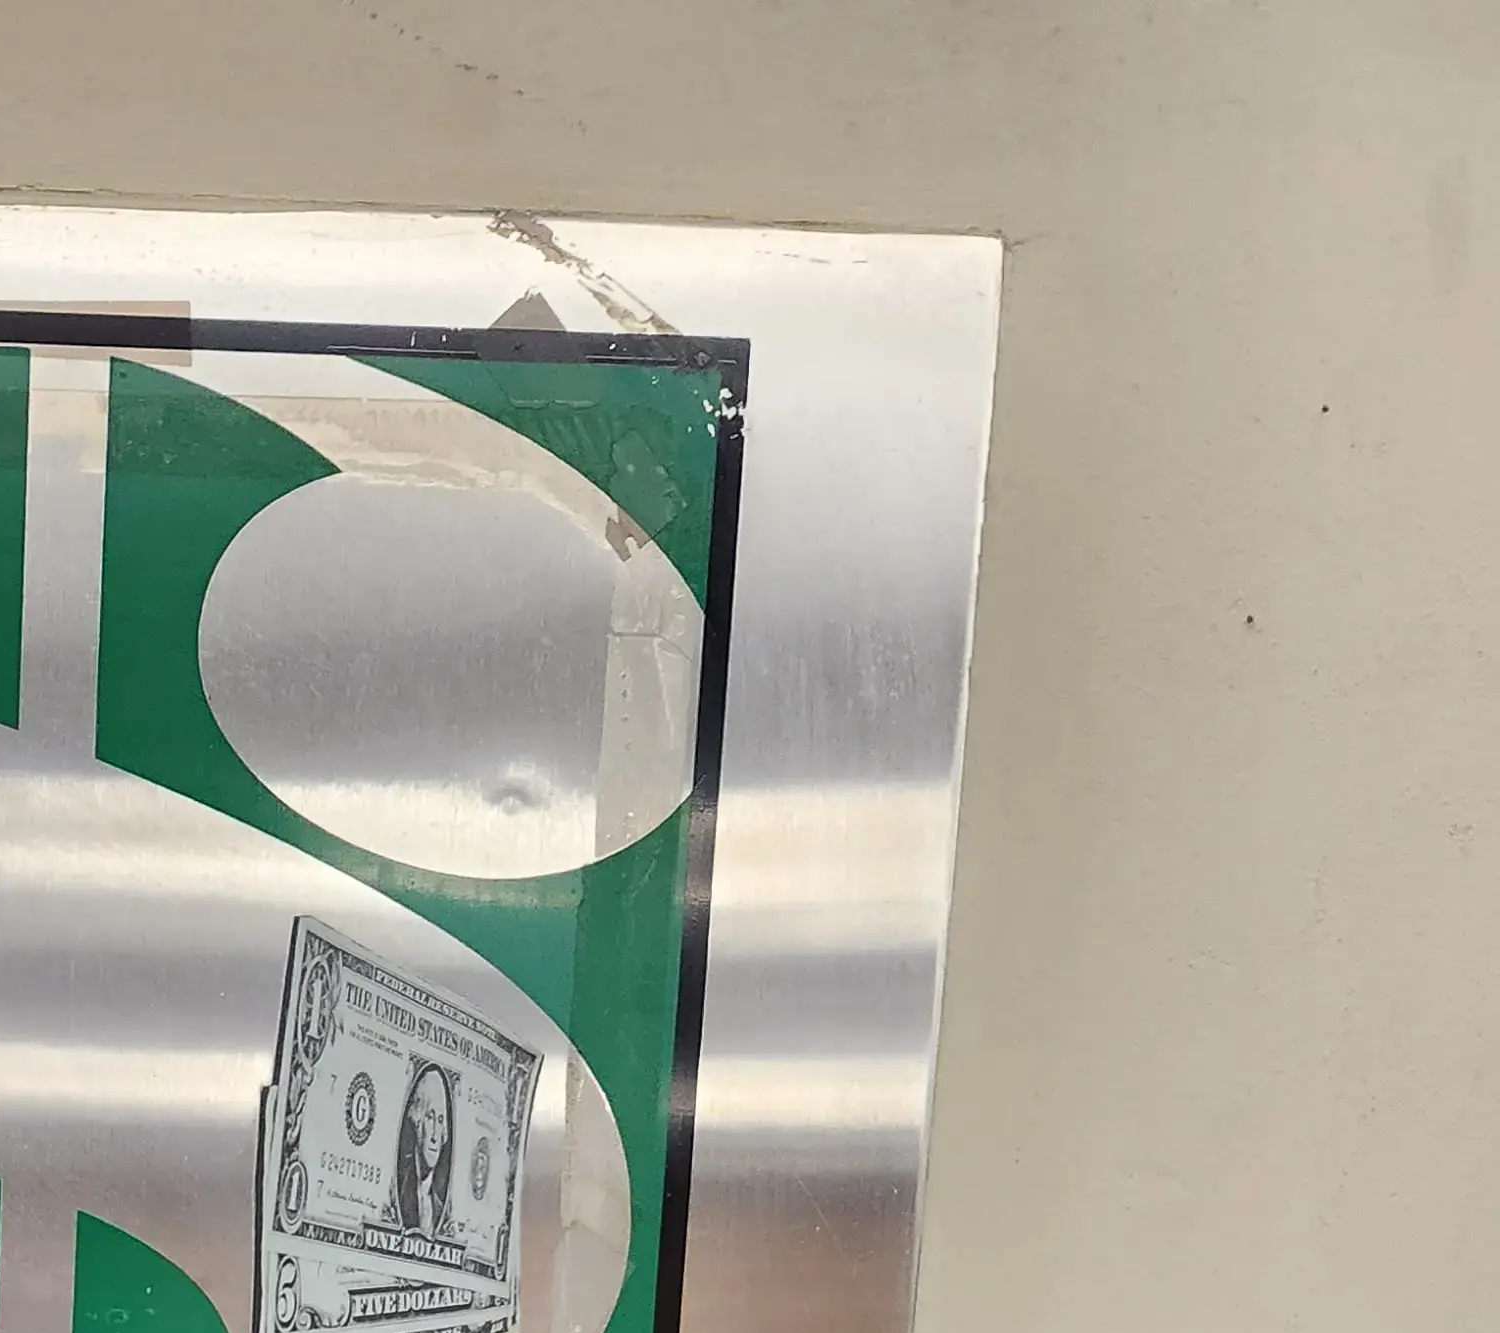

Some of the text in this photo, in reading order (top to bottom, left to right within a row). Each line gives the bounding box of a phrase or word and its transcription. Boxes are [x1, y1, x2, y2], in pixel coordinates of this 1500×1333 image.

[345, 981, 373, 1013] THE
[375, 994, 417, 1034] UNITED
[417, 1016, 459, 1055] STATES
[459, 1035, 474, 1061] OF
[365, 1230, 401, 1254] ONE
[352, 1291, 400, 1317] FIVE
